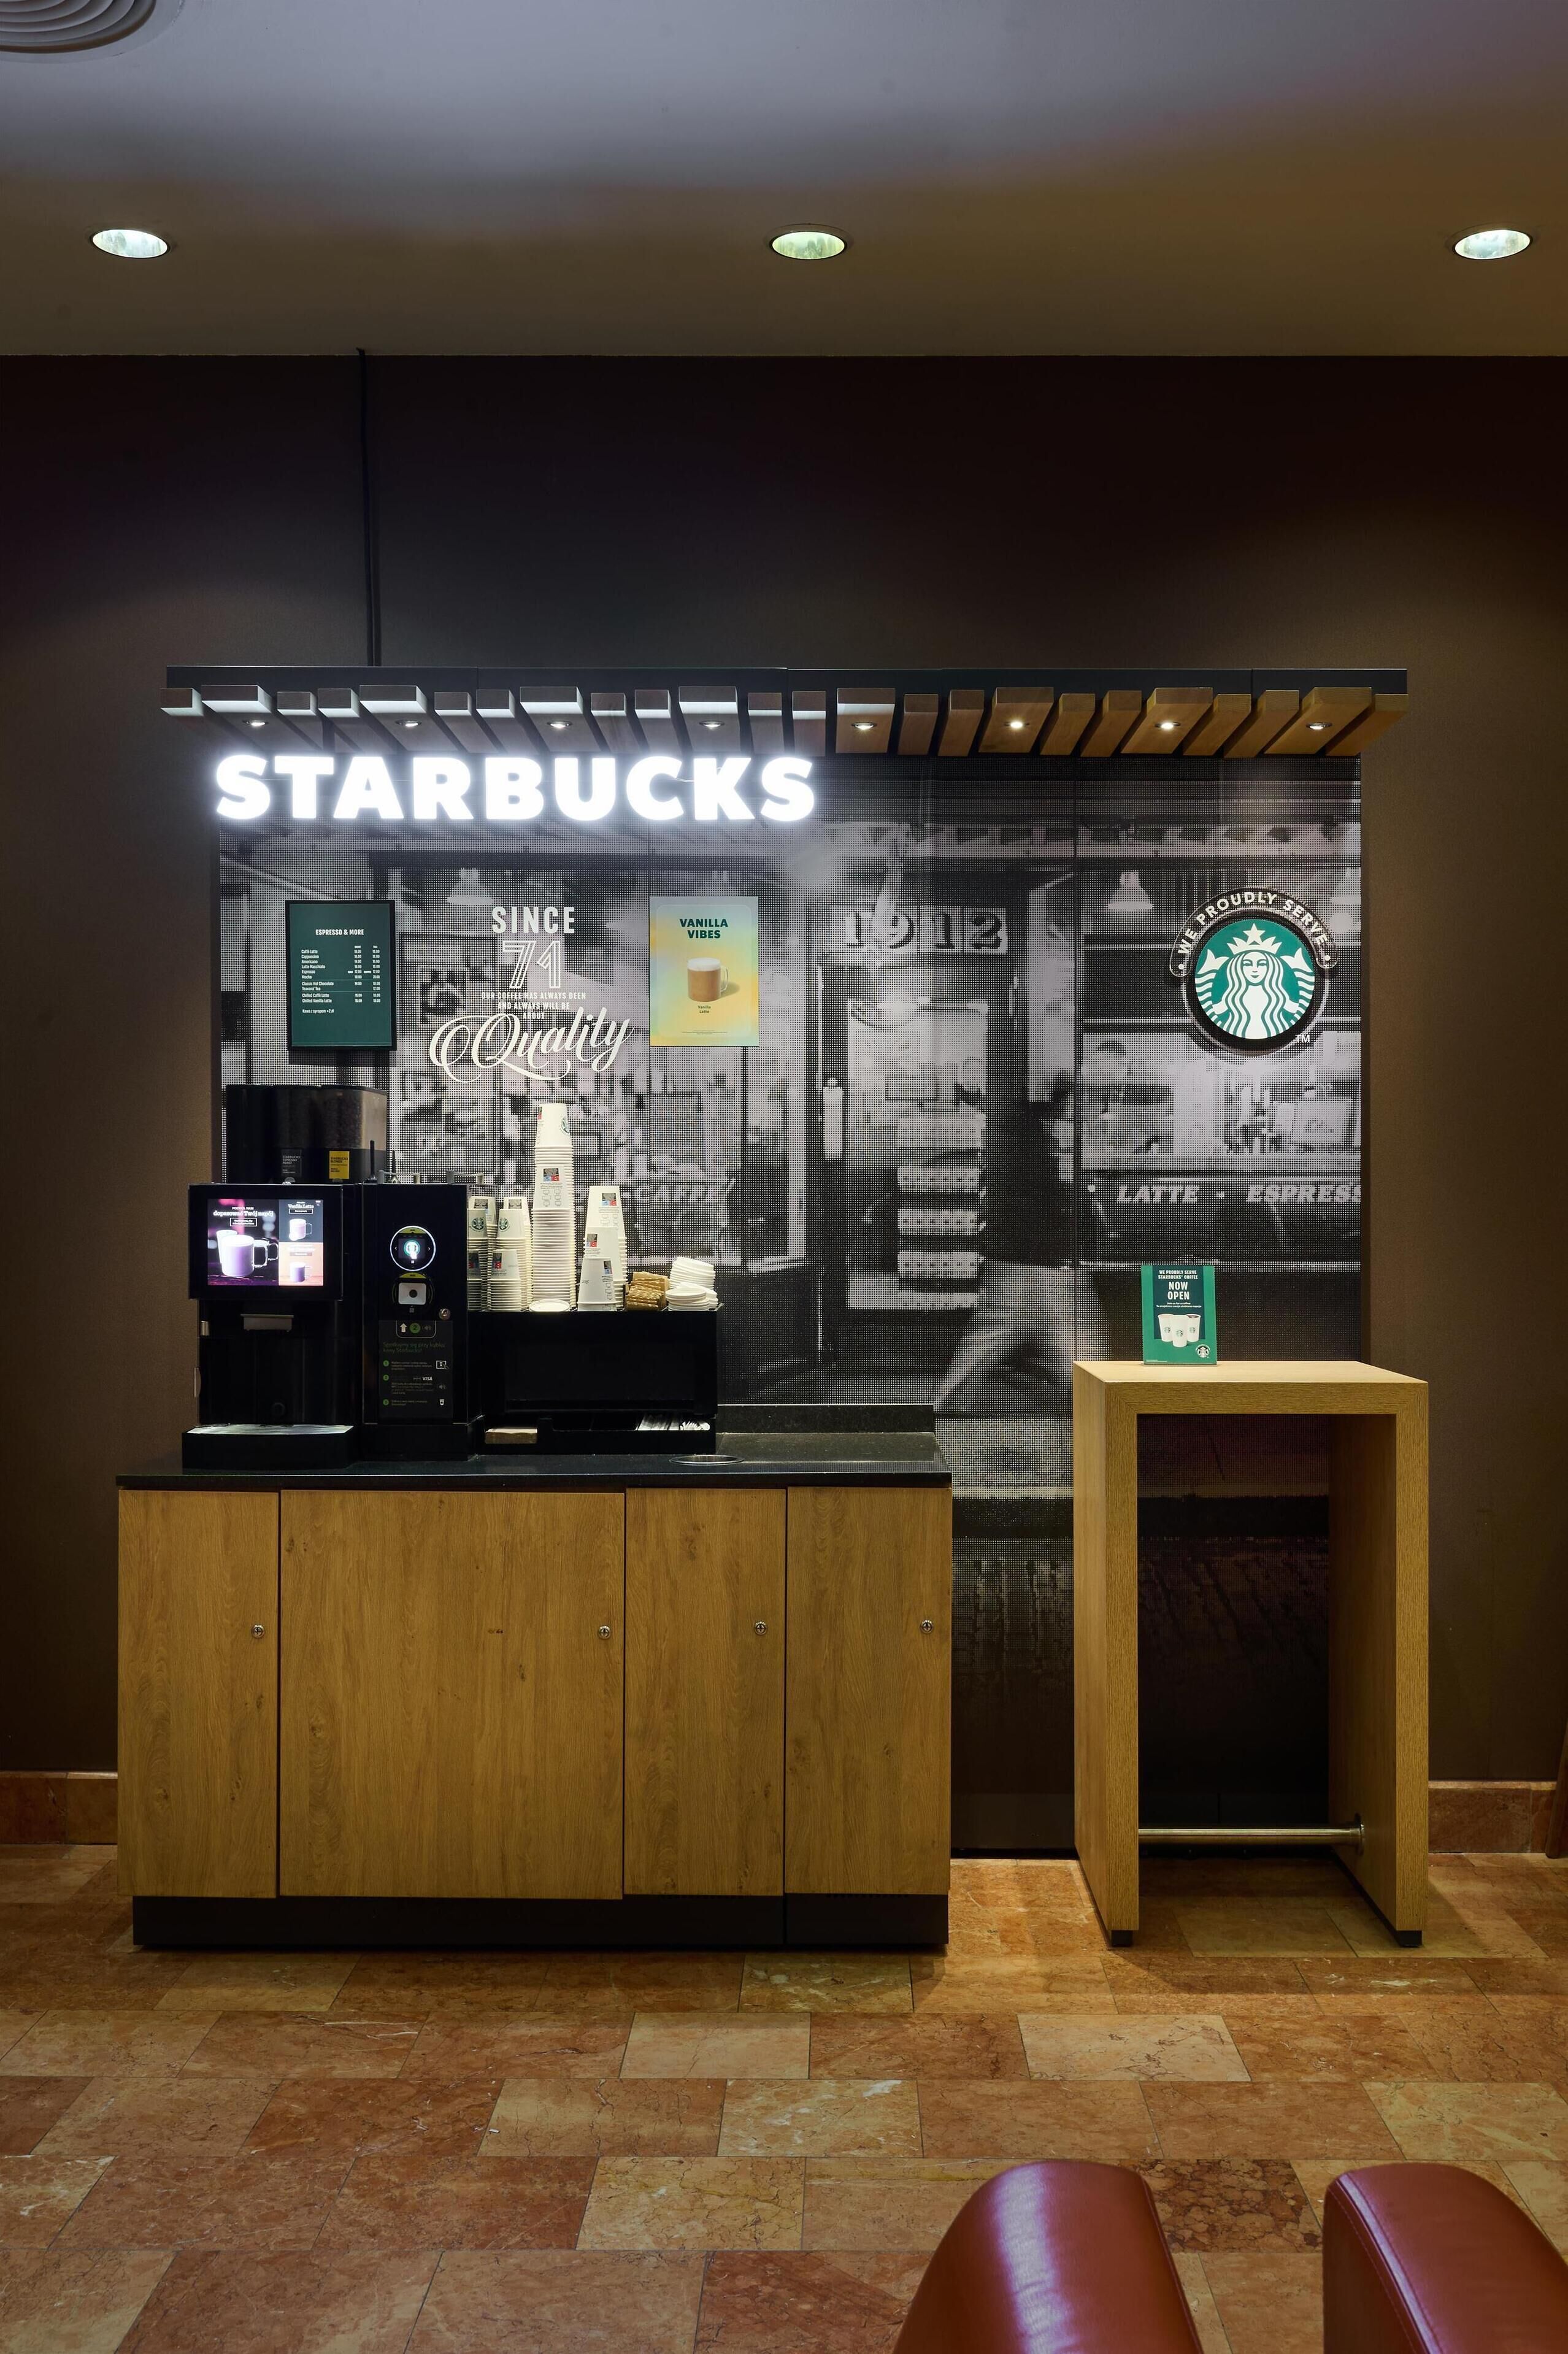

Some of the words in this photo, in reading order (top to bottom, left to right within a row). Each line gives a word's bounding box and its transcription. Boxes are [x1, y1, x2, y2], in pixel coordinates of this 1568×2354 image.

[215, 756, 815, 822] STARBUCKS
[492, 906, 575, 934] SINCE
[680, 918, 728, 928] VANILLA
[845, 912, 1002, 949] 1912
[1178, 928, 1197, 955] WE
[1196, 891, 1277, 925] PROUDLY
[1283, 899, 1329, 945] SERVE
[687, 930, 721, 939] VIBES
[502, 940, 561, 988] 71
[429, 1007, 634, 1083] Quality
[1116, 1184, 1200, 1204] LATTE
[1167, 1291, 1189, 1300] OPEN
[1169, 1282, 1188, 1290] NOW
